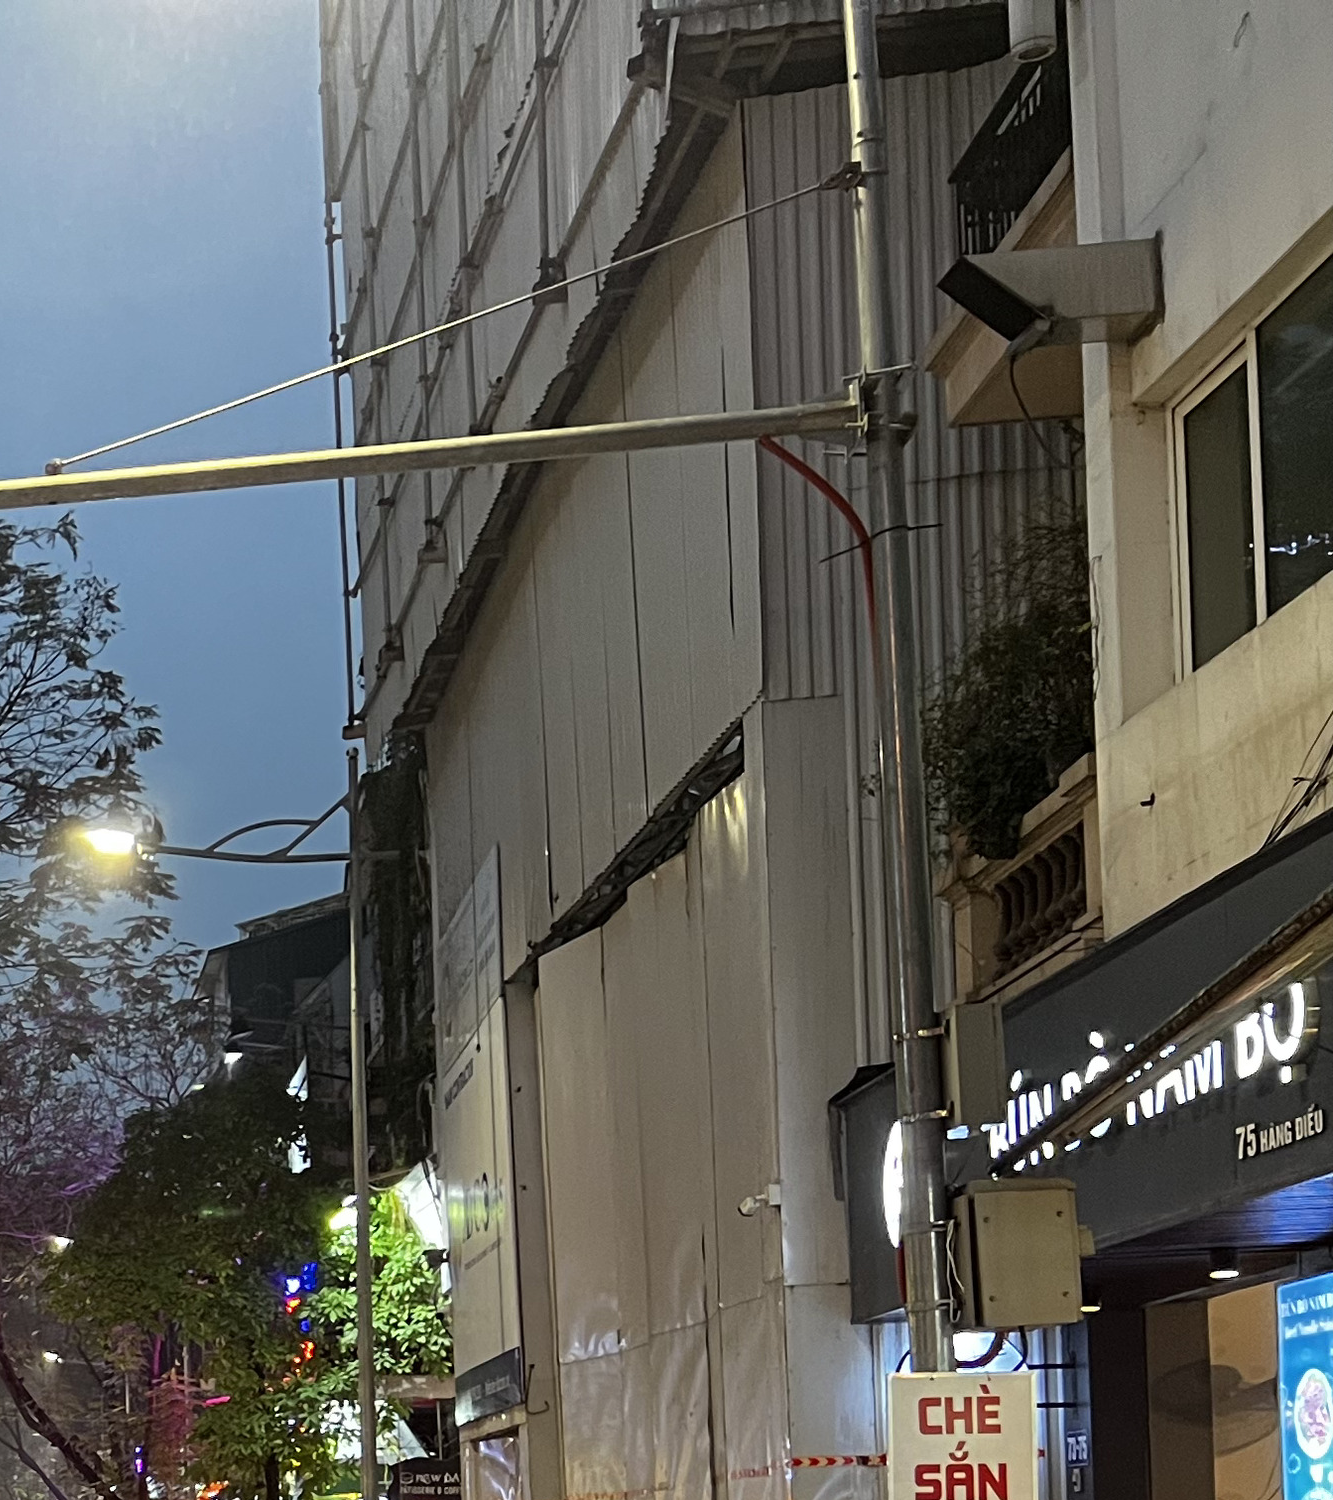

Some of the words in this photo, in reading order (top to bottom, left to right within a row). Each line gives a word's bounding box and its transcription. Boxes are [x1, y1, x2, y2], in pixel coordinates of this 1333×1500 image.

[1235, 1122, 1257, 1160] 75
[1259, 1122, 1293, 1153] HÀNG
[918, 1383, 1002, 1436] CHÈ
